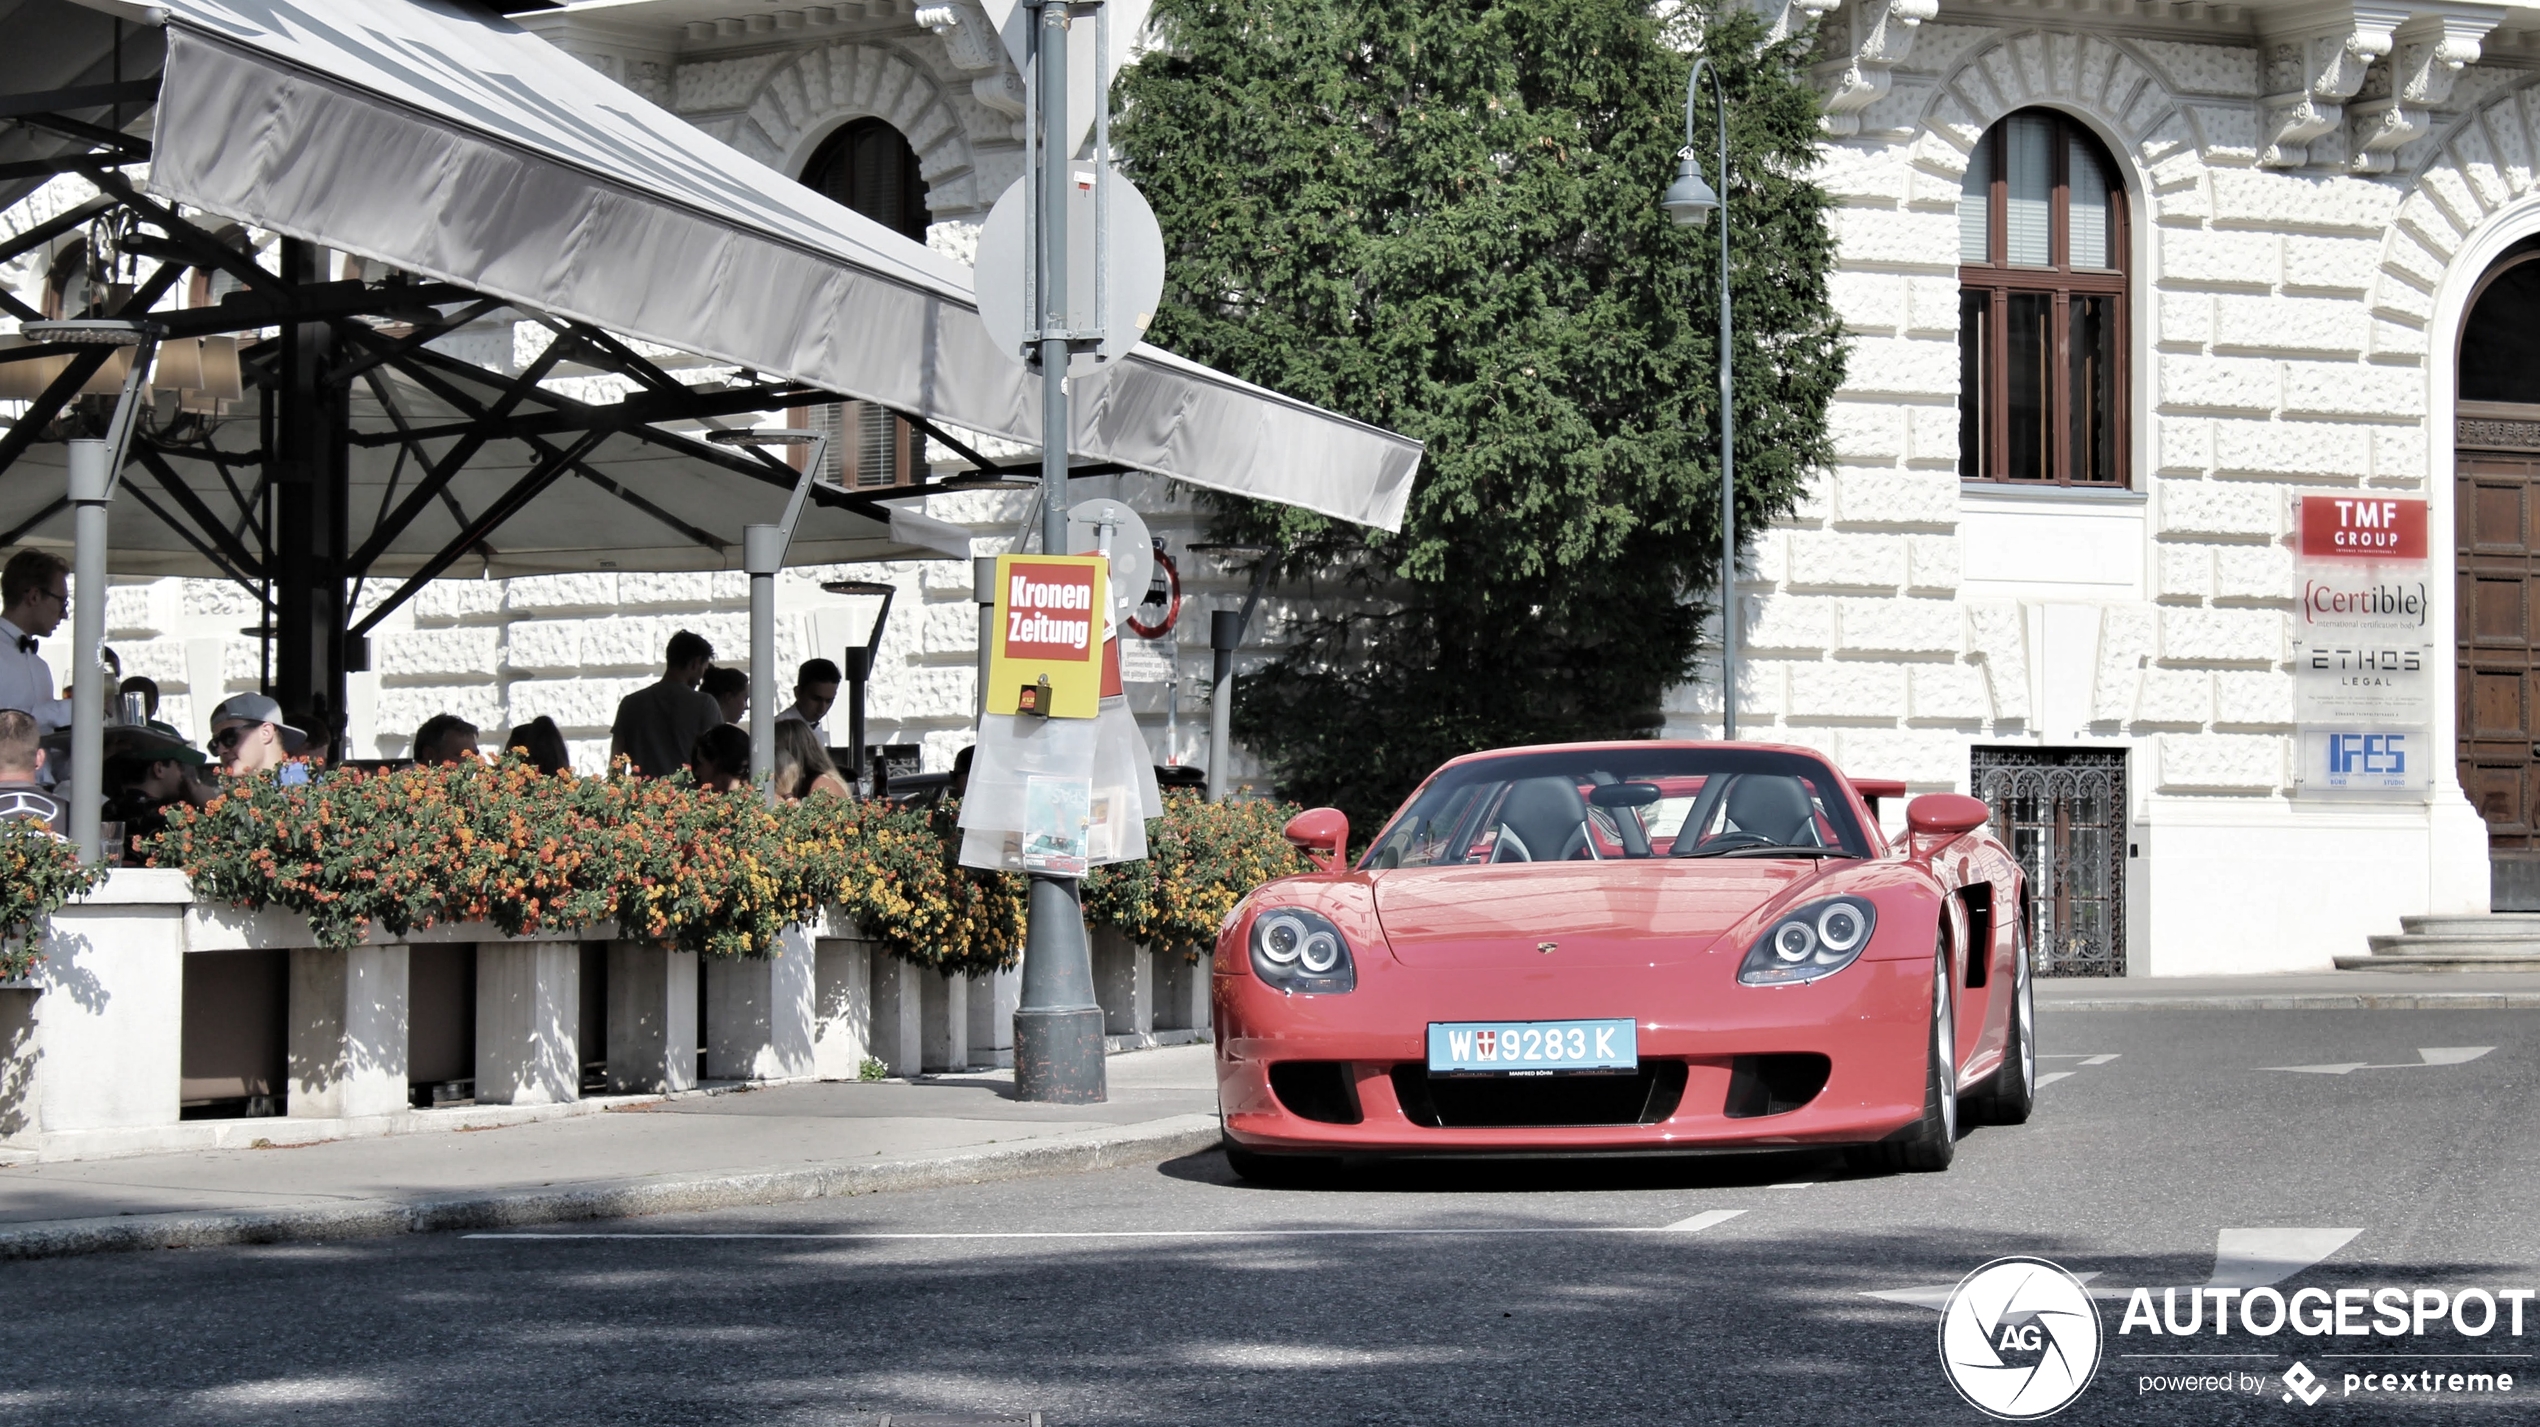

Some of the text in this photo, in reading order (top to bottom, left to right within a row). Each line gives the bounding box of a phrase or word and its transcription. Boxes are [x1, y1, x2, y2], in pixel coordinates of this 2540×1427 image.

[2335, 501, 2396, 529] TMF
[2334, 531, 2398, 547] GROUP
[1011, 575, 1091, 610] Kronen
[1008, 612, 1089, 649] Zeitung
[2316, 620, 2415, 631] international certification body
[2312, 649, 2420, 671] ETHOS
[2341, 676, 2392, 686] LEGAL
[2330, 734, 2405, 773] IFES
[2330, 778, 2347, 786] BÜRO
[1448, 1026, 1616, 1062] W 9283 K
[1535, 1069, 1553, 1077] BÖHM
